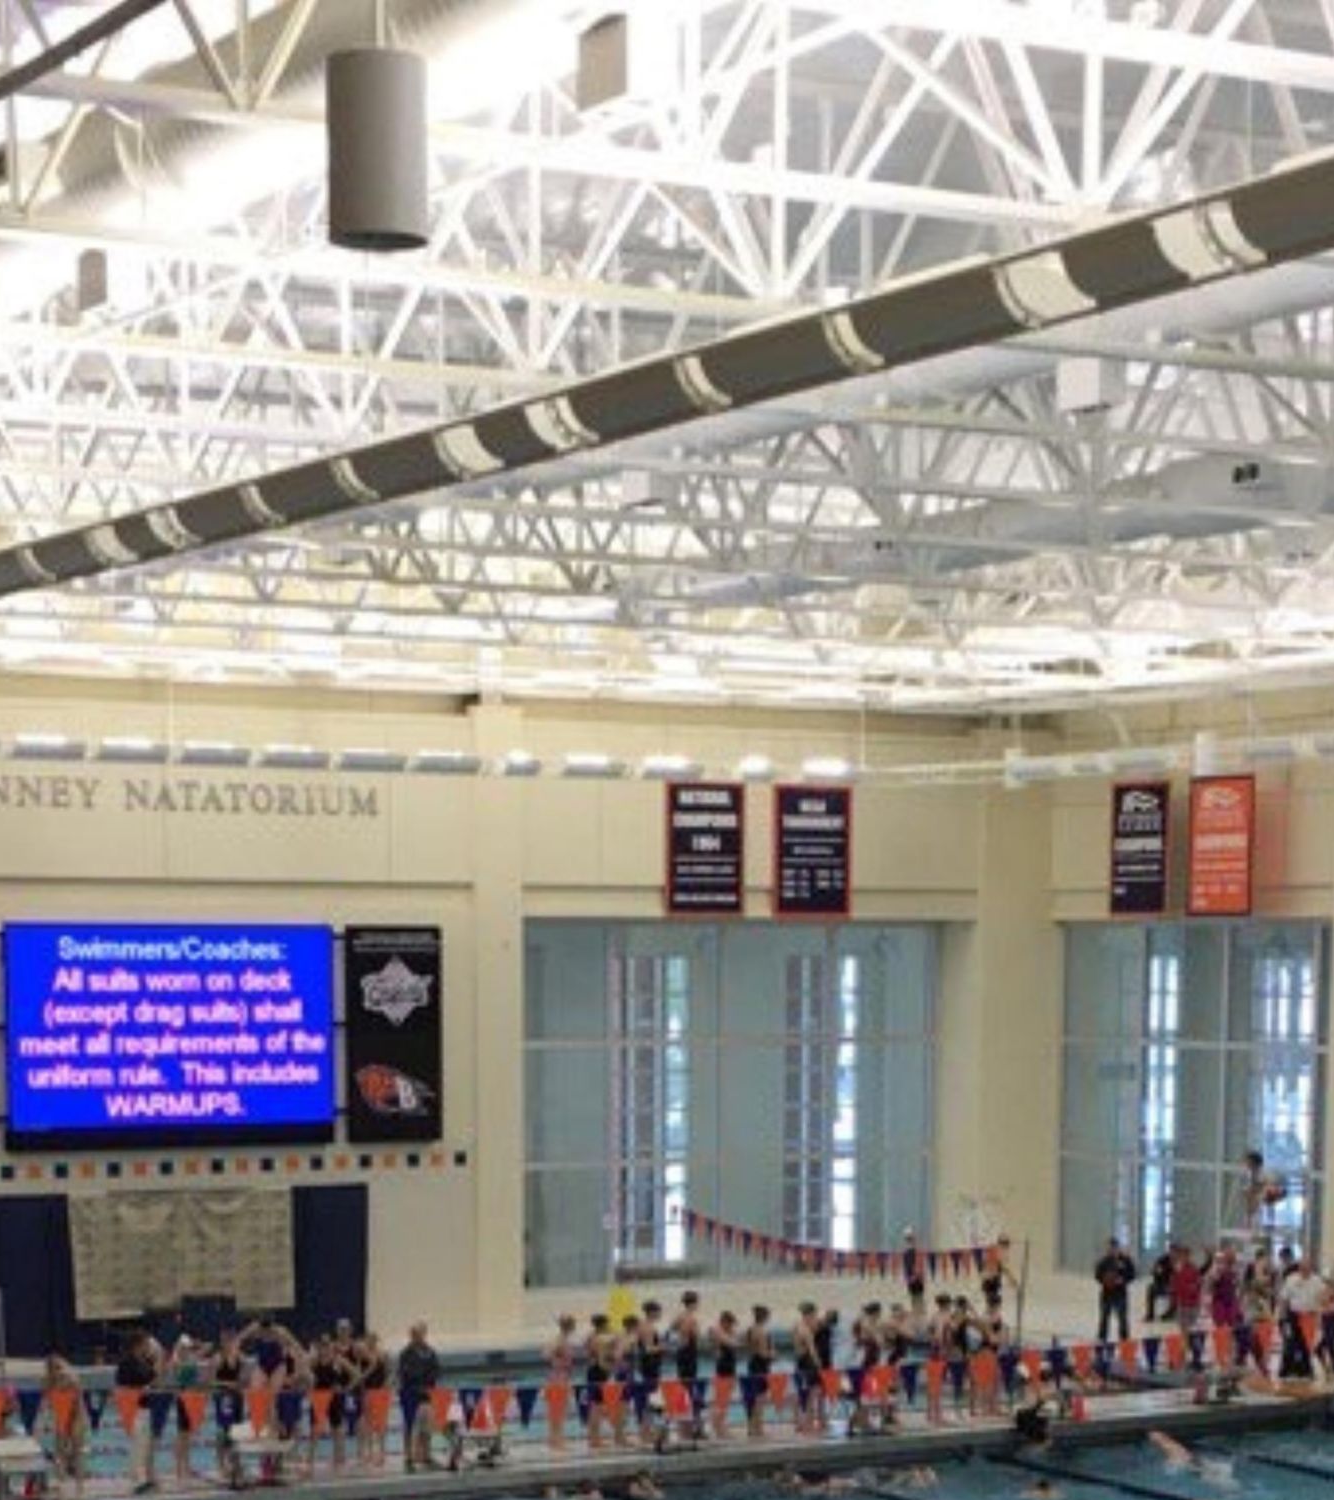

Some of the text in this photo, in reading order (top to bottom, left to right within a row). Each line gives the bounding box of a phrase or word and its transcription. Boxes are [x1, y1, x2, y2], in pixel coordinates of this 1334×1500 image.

[123, 778, 380, 818] NATATORIUM
[58, 935, 288, 961] Swimmers/Coaches:
[52, 967, 292, 992] All suits worn on deck
[43, 998, 304, 1028] (except drag suits) shall
[19, 1030, 326, 1058] meet all requirements of the
[27, 1061, 320, 1088] uniform rule. This includes
[105, 1092, 247, 1117] WARMUPS.
